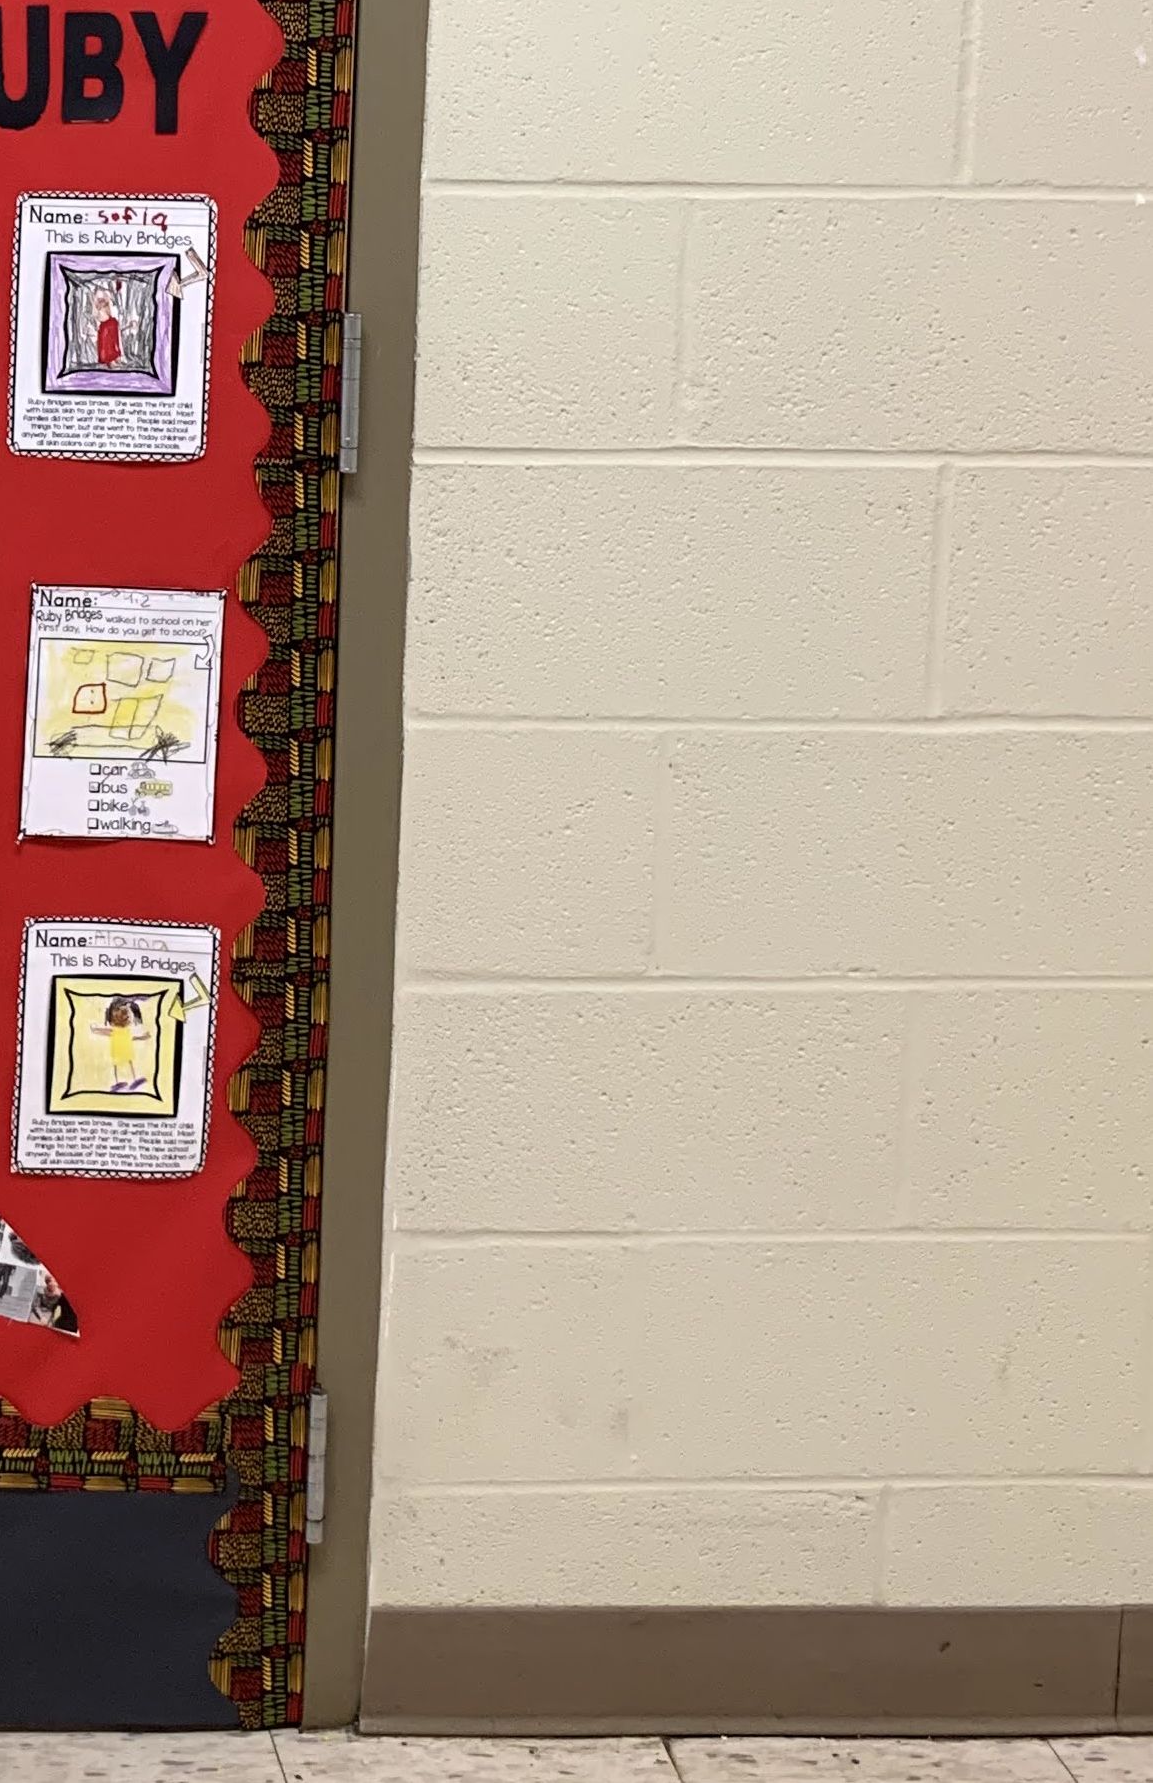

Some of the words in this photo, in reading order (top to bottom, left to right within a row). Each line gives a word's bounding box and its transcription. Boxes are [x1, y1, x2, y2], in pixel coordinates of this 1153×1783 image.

[30, 205, 88, 224] Name:
[45, 229, 73, 243] This
[78, 231, 89, 243] is
[94, 230, 132, 247] Ruby
[40, 590, 97, 607] Name:
[36, 610, 62, 626] Ruby
[65, 609, 102, 623] Bridges
[105, 615, 136, 624] walked
[138, 616, 149, 624] to
[151, 617, 180, 625] school
[196, 619, 212, 627] her
[38, 623, 60, 631] first
[85, 625, 104, 633] How
[108, 626, 119, 634] do
[122, 628, 139, 637] you
[141, 627, 157, 637] get
[159, 627, 170, 635] to
[172, 628, 208, 636] school?
[102, 764, 128, 776] car
[100, 782, 127, 794] bus
[100, 799, 129, 812] bike
[100, 817, 151, 834] walking
[36, 930, 92, 948] Name:
[50, 953, 78, 967] This
[82, 953, 93, 966] is
[98, 954, 136, 971] Ruby
